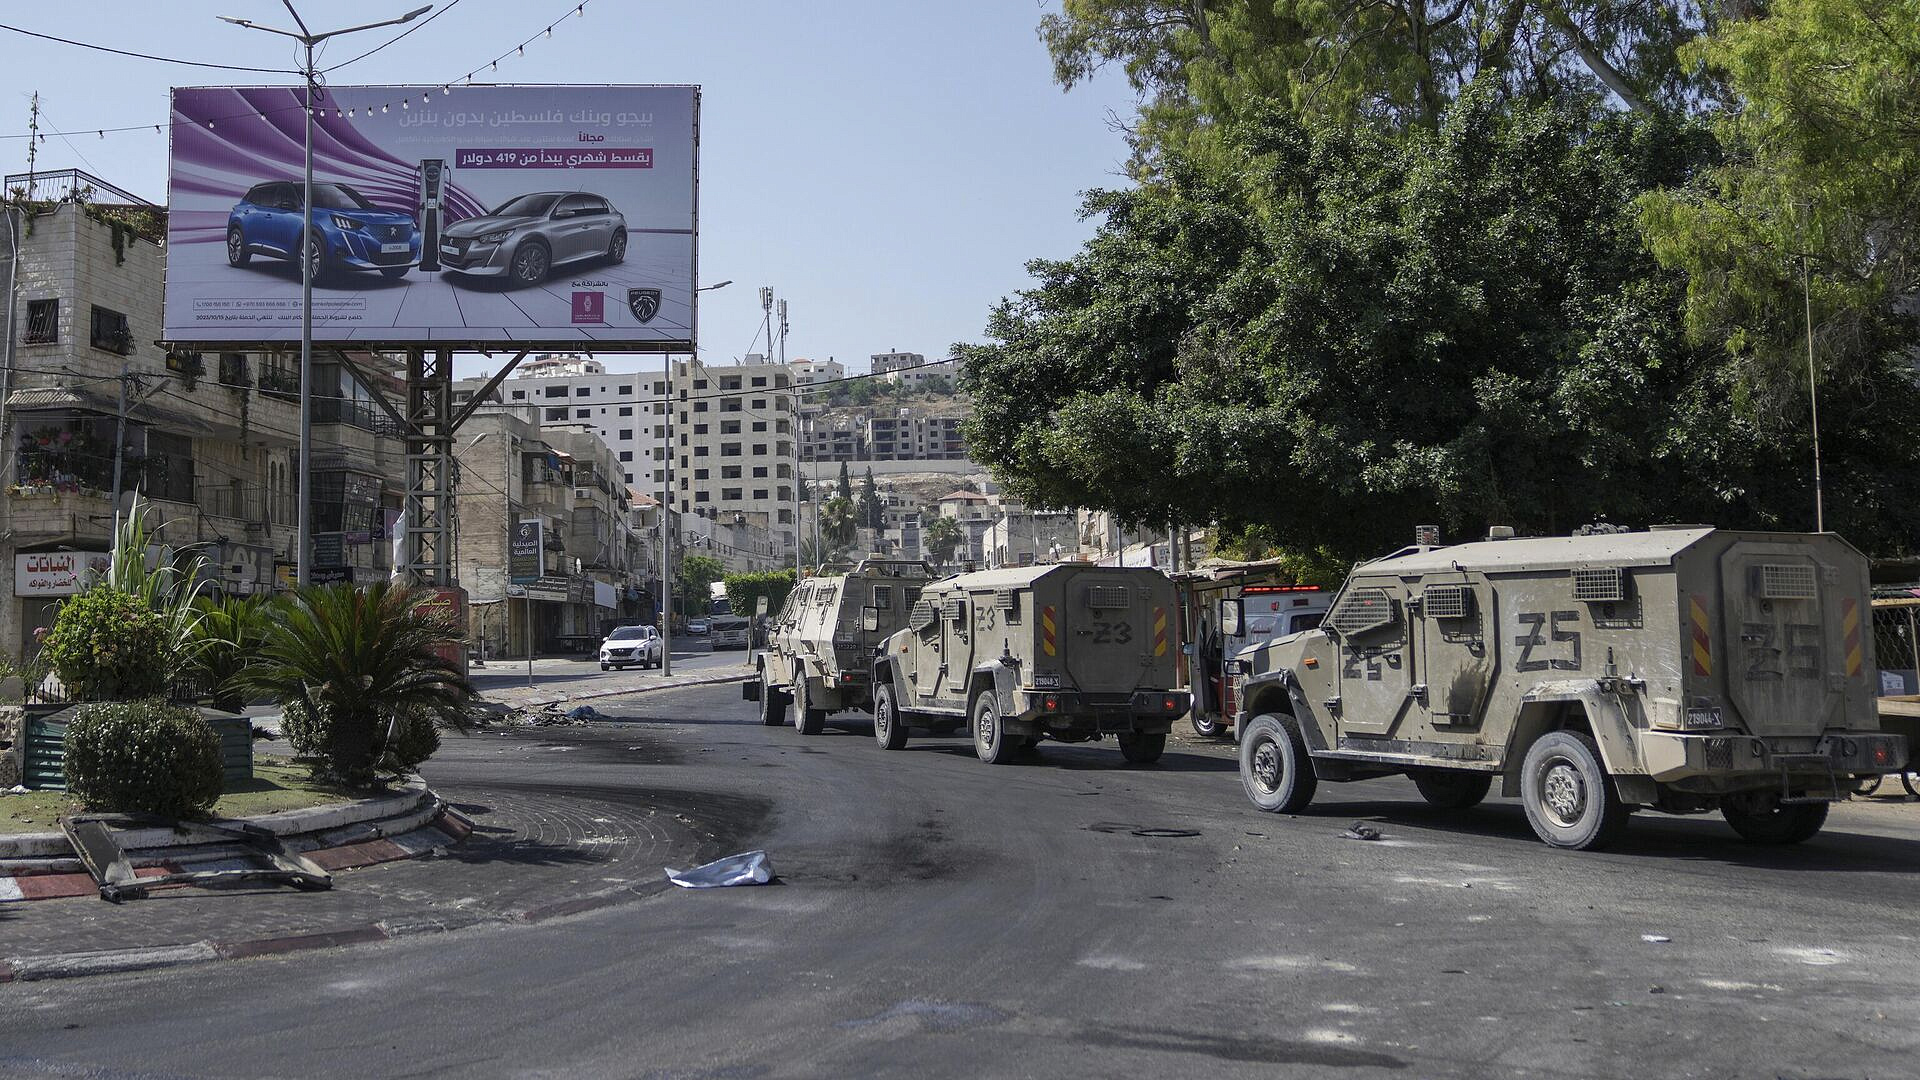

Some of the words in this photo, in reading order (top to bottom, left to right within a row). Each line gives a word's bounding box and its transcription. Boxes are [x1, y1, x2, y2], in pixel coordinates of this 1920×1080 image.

[399, 110, 439, 127] بنزين
[443, 110, 485, 126] بدون
[489, 109, 564, 127] فلسطين
[569, 108, 611, 126] وبنك
[615, 110, 654, 126] بيجو
[578, 131, 605, 144] مجاناً
[462, 152, 494, 165] دولار
[496, 152, 517, 163] 419
[519, 153, 538, 165] من
[540, 149, 563, 166] يبدأ
[569, 151, 607, 168] شهري
[610, 151, 650, 164] بقسط
[976, 605, 995, 631] Z3
[1093, 621, 1132, 645] Z3
[1515, 610, 1582, 673] Z5
[1742, 623, 1821, 681] Z5
[1342, 645, 1382, 681] Z5
